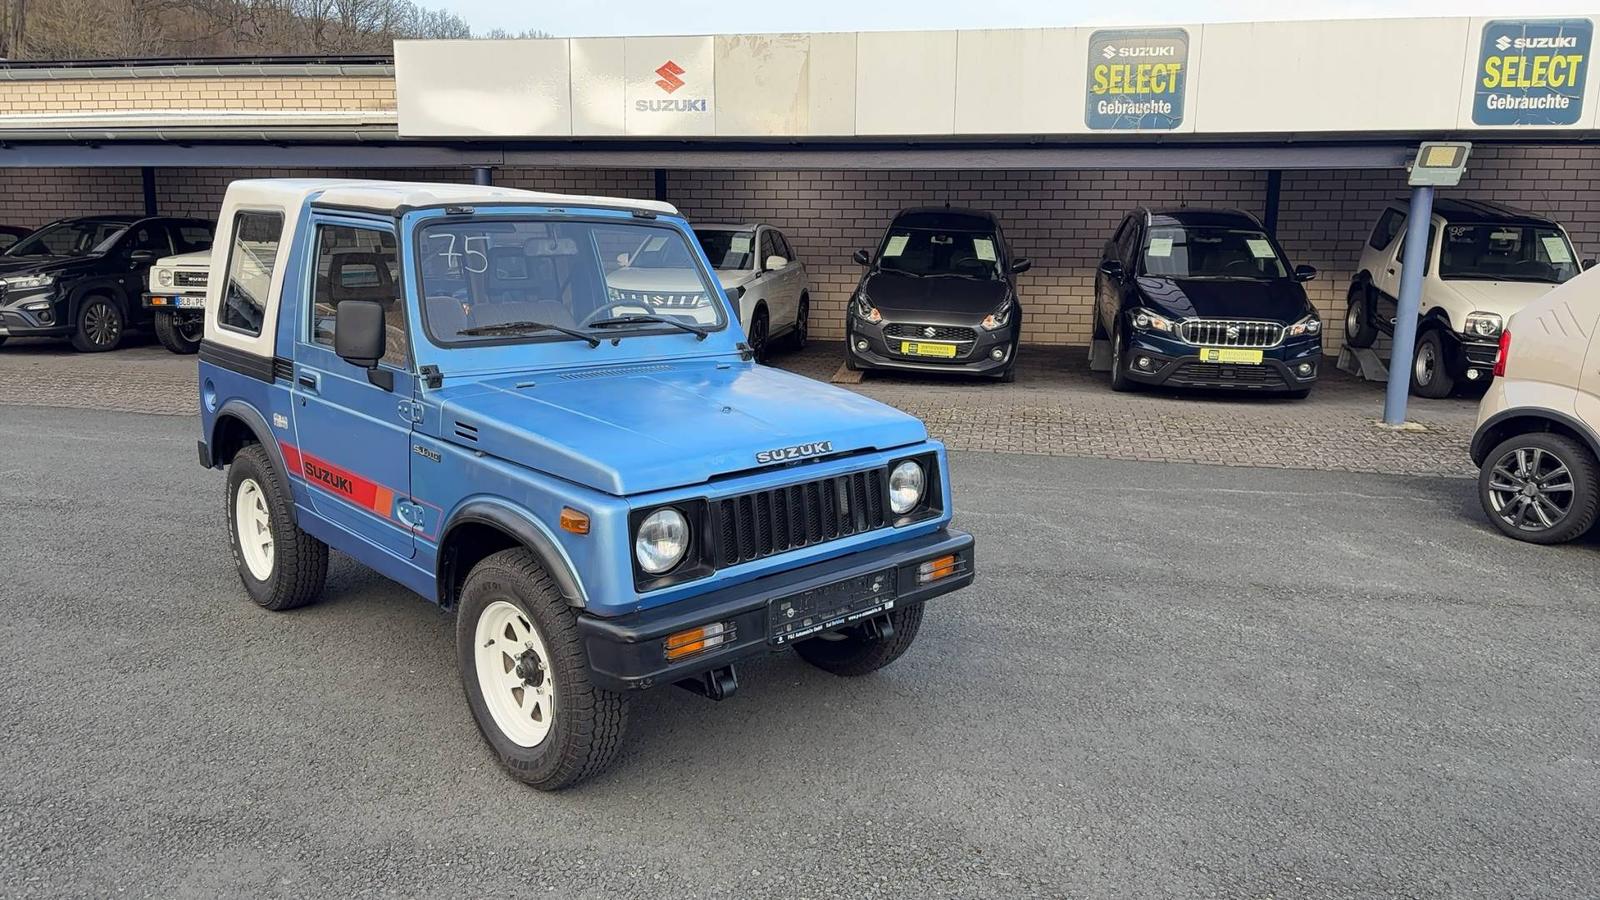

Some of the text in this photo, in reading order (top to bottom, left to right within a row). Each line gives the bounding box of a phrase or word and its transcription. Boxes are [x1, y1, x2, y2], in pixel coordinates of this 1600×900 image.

[1514, 37, 1577, 48] SUZUKI
[1119, 46, 1174, 57] SUZUKI
[1093, 63, 1181, 94] SELECT
[1483, 55, 1582, 88] SELECT
[635, 99, 706, 112] SUZUKI
[1098, 100, 1171, 115] Gebrauchte
[1487, 93, 1570, 110] Gebrauchte
[1451, 226, 1466, 237] 98
[429, 233, 490, 273] 75
[757, 441, 833, 463] SUZUKI
[304, 461, 352, 494] SUZUKI
